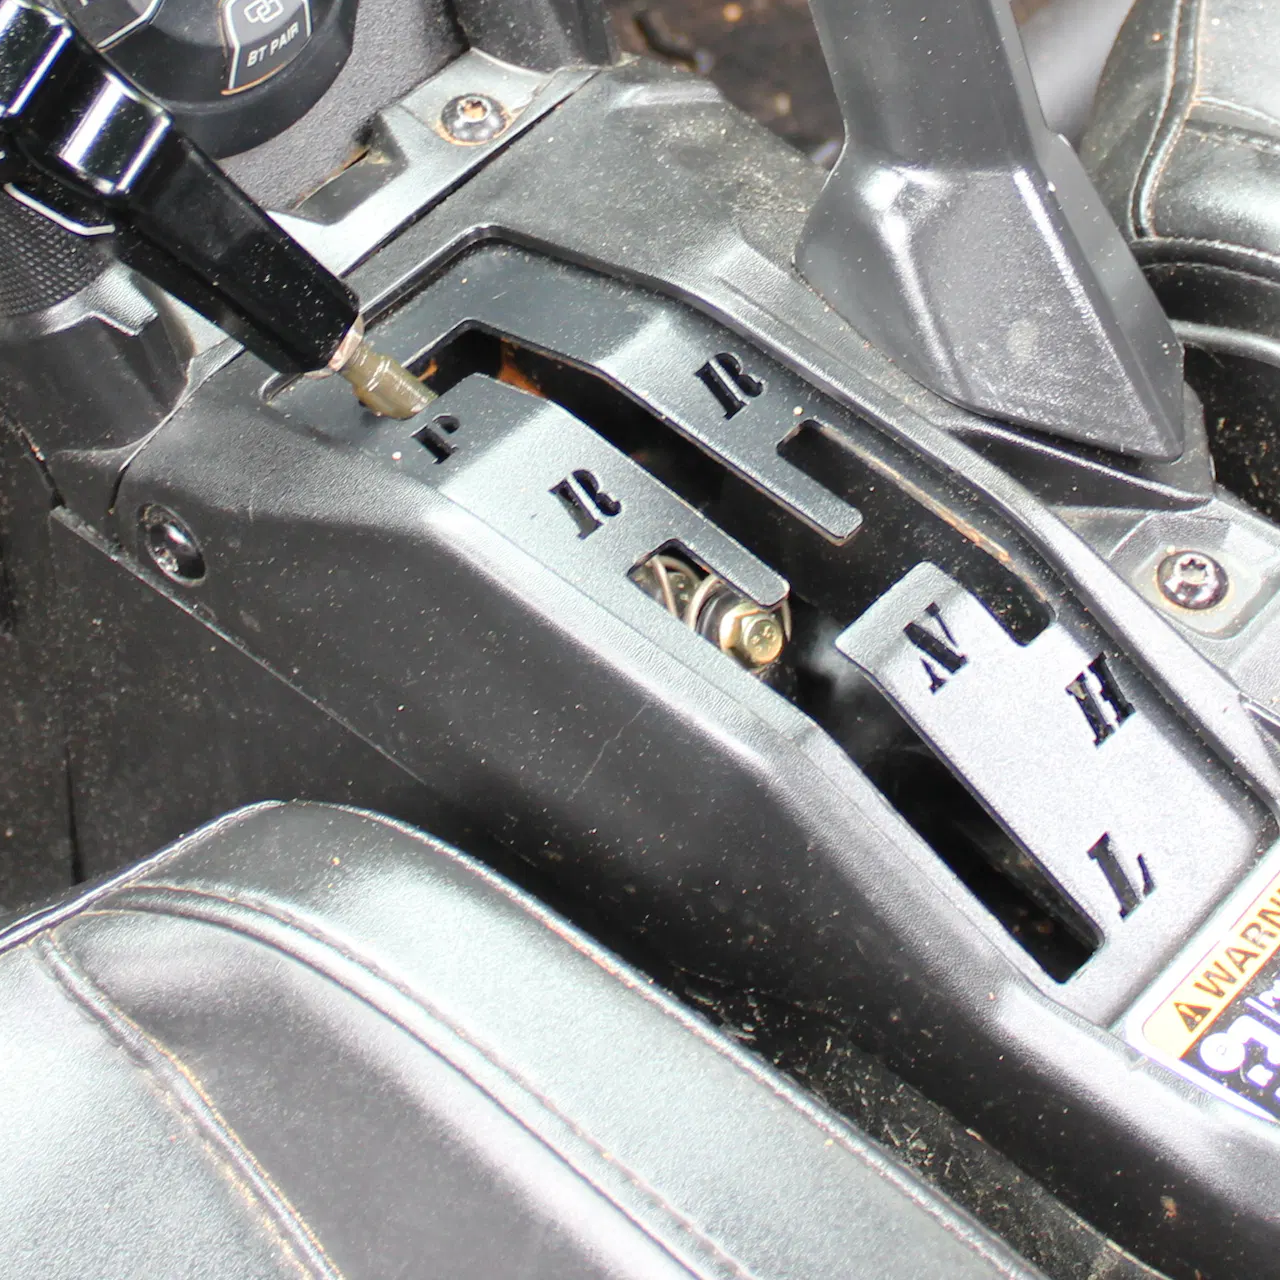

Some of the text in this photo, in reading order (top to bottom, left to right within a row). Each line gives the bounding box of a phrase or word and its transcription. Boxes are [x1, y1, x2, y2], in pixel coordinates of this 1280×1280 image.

[246, 22, 300, 67] BT PAIR
[694, 351, 764, 420] R
[410, 412, 462, 466] P
[547, 468, 622, 540] R
[902, 602, 968, 694] N
[1064, 651, 1137, 747] H
[1086, 831, 1157, 922] L
